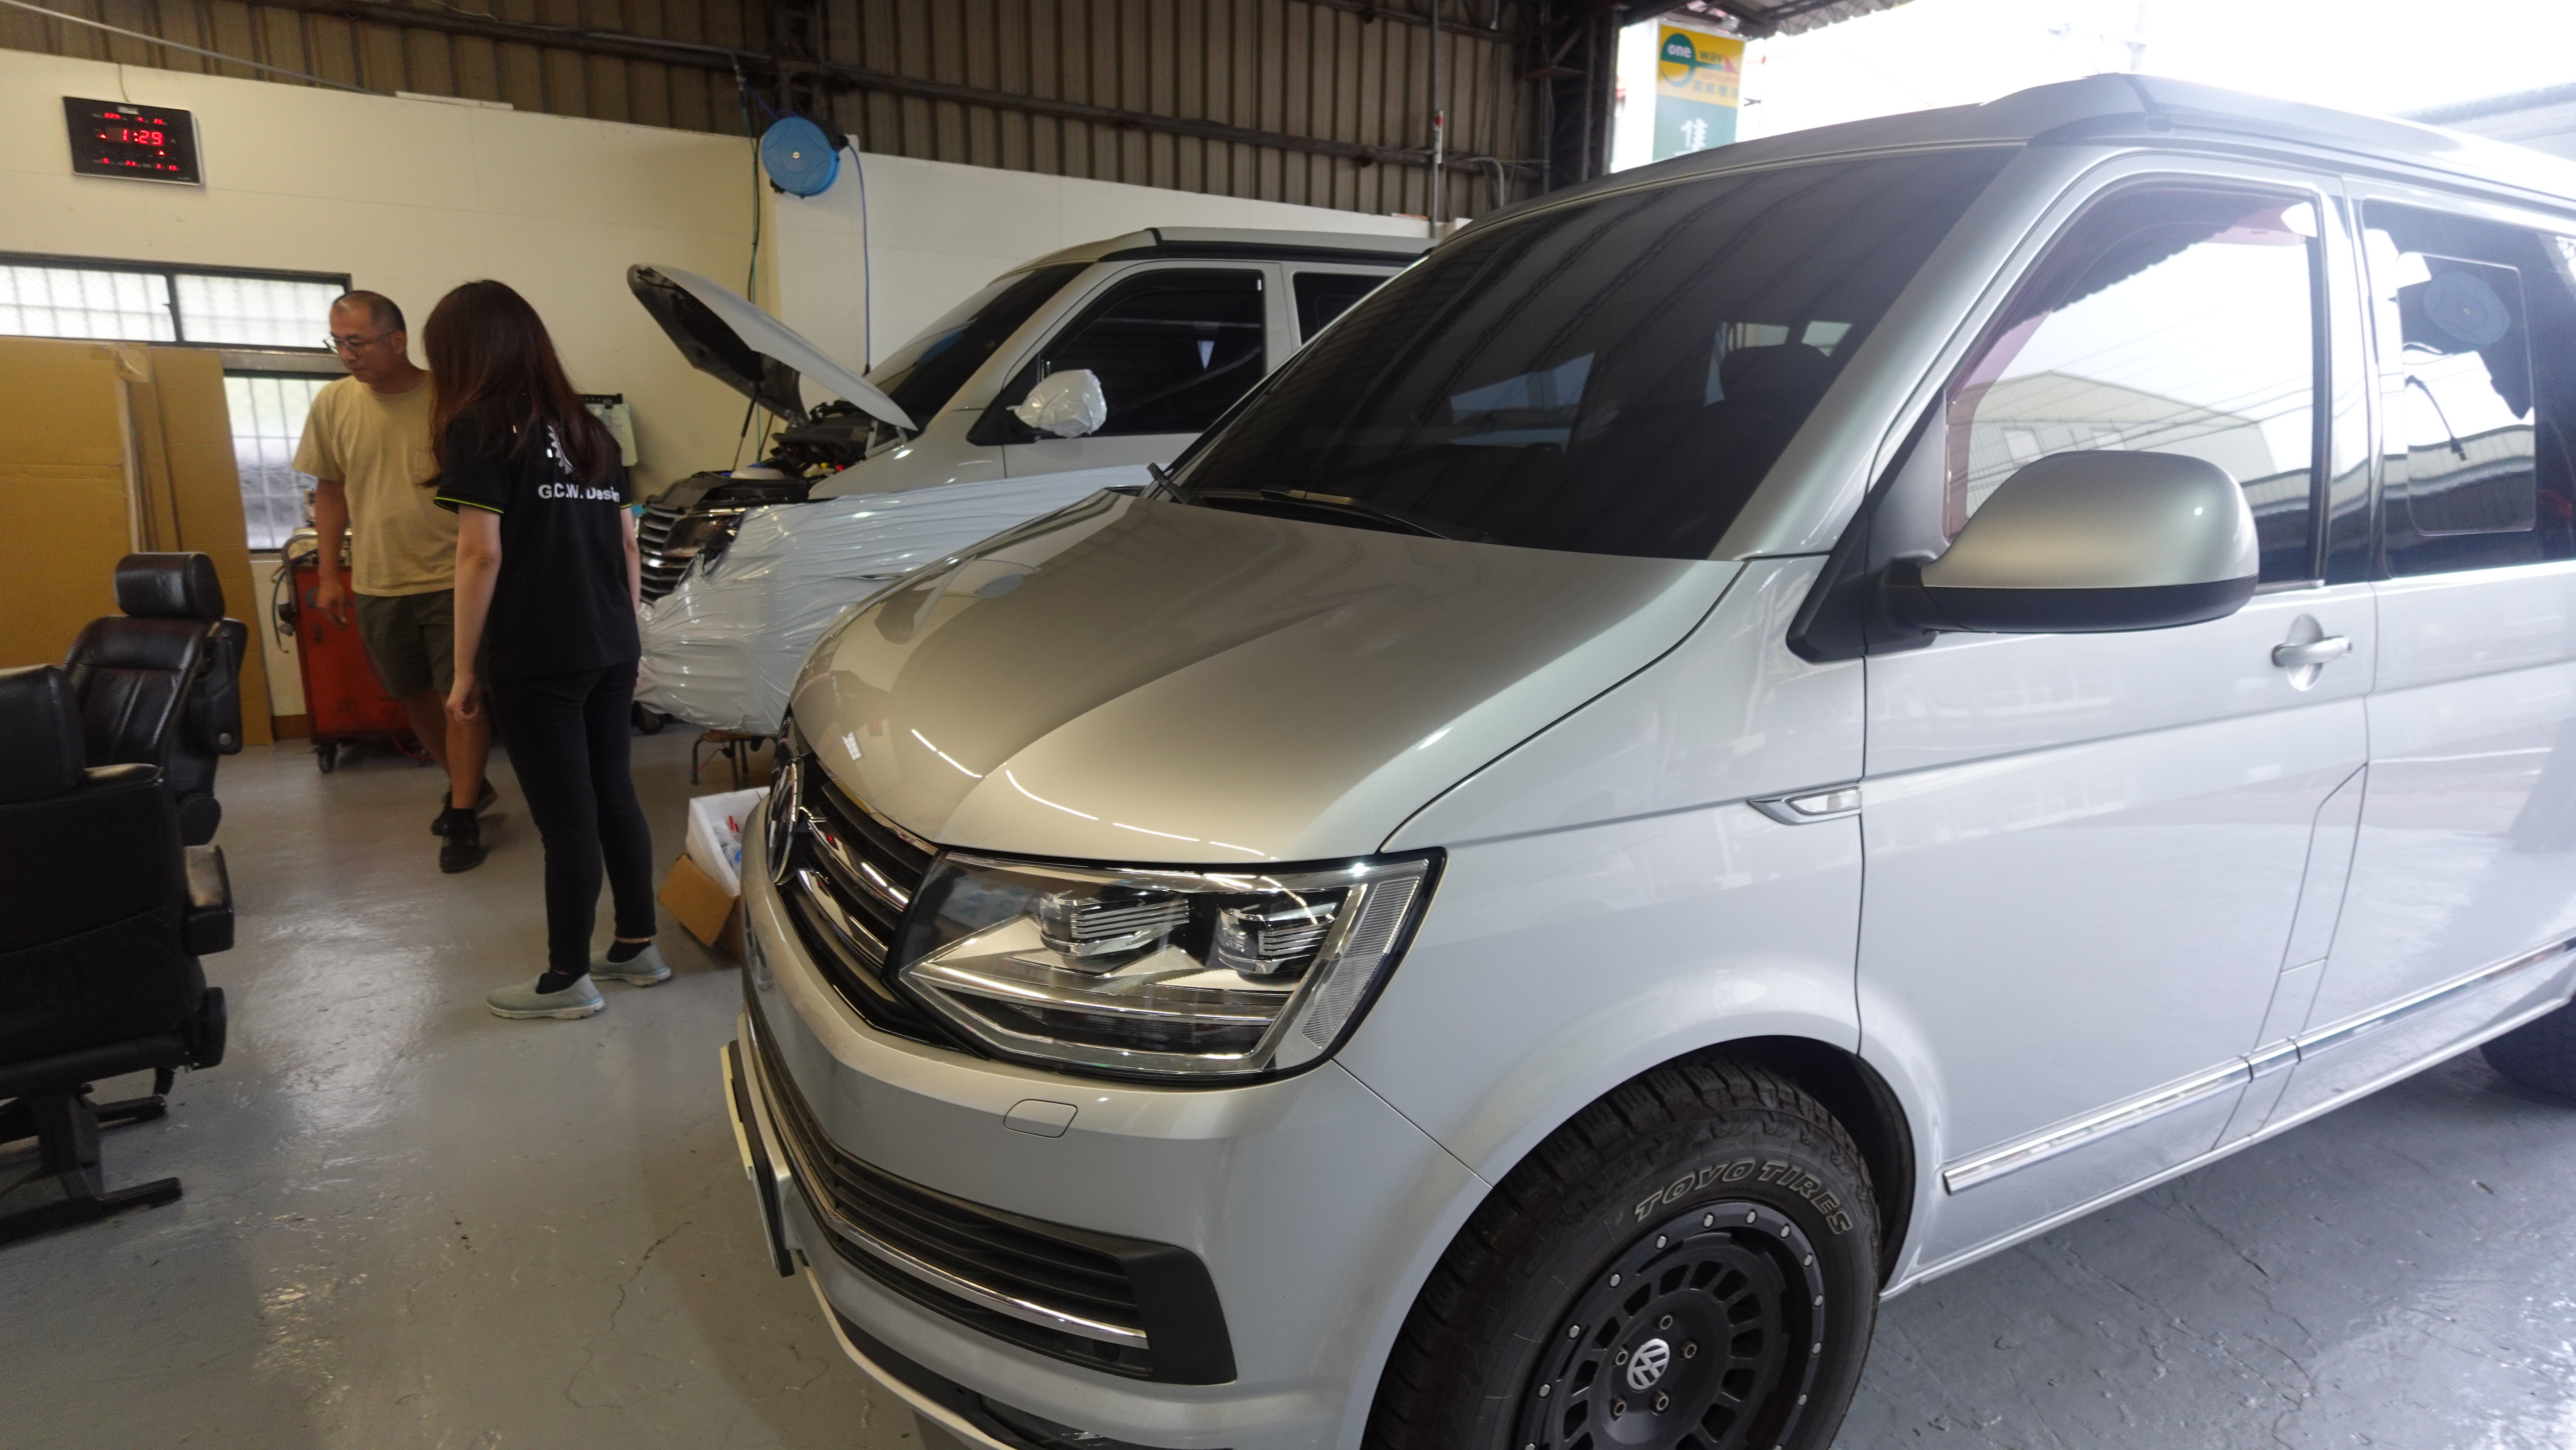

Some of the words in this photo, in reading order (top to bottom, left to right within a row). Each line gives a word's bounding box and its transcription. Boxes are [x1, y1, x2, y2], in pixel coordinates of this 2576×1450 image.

[1668, 44, 1692, 58] one
[123, 129, 163, 146] 1:29
[1635, 1160, 1755, 1222] TOYO
[1758, 1161, 1852, 1235] TIRES
